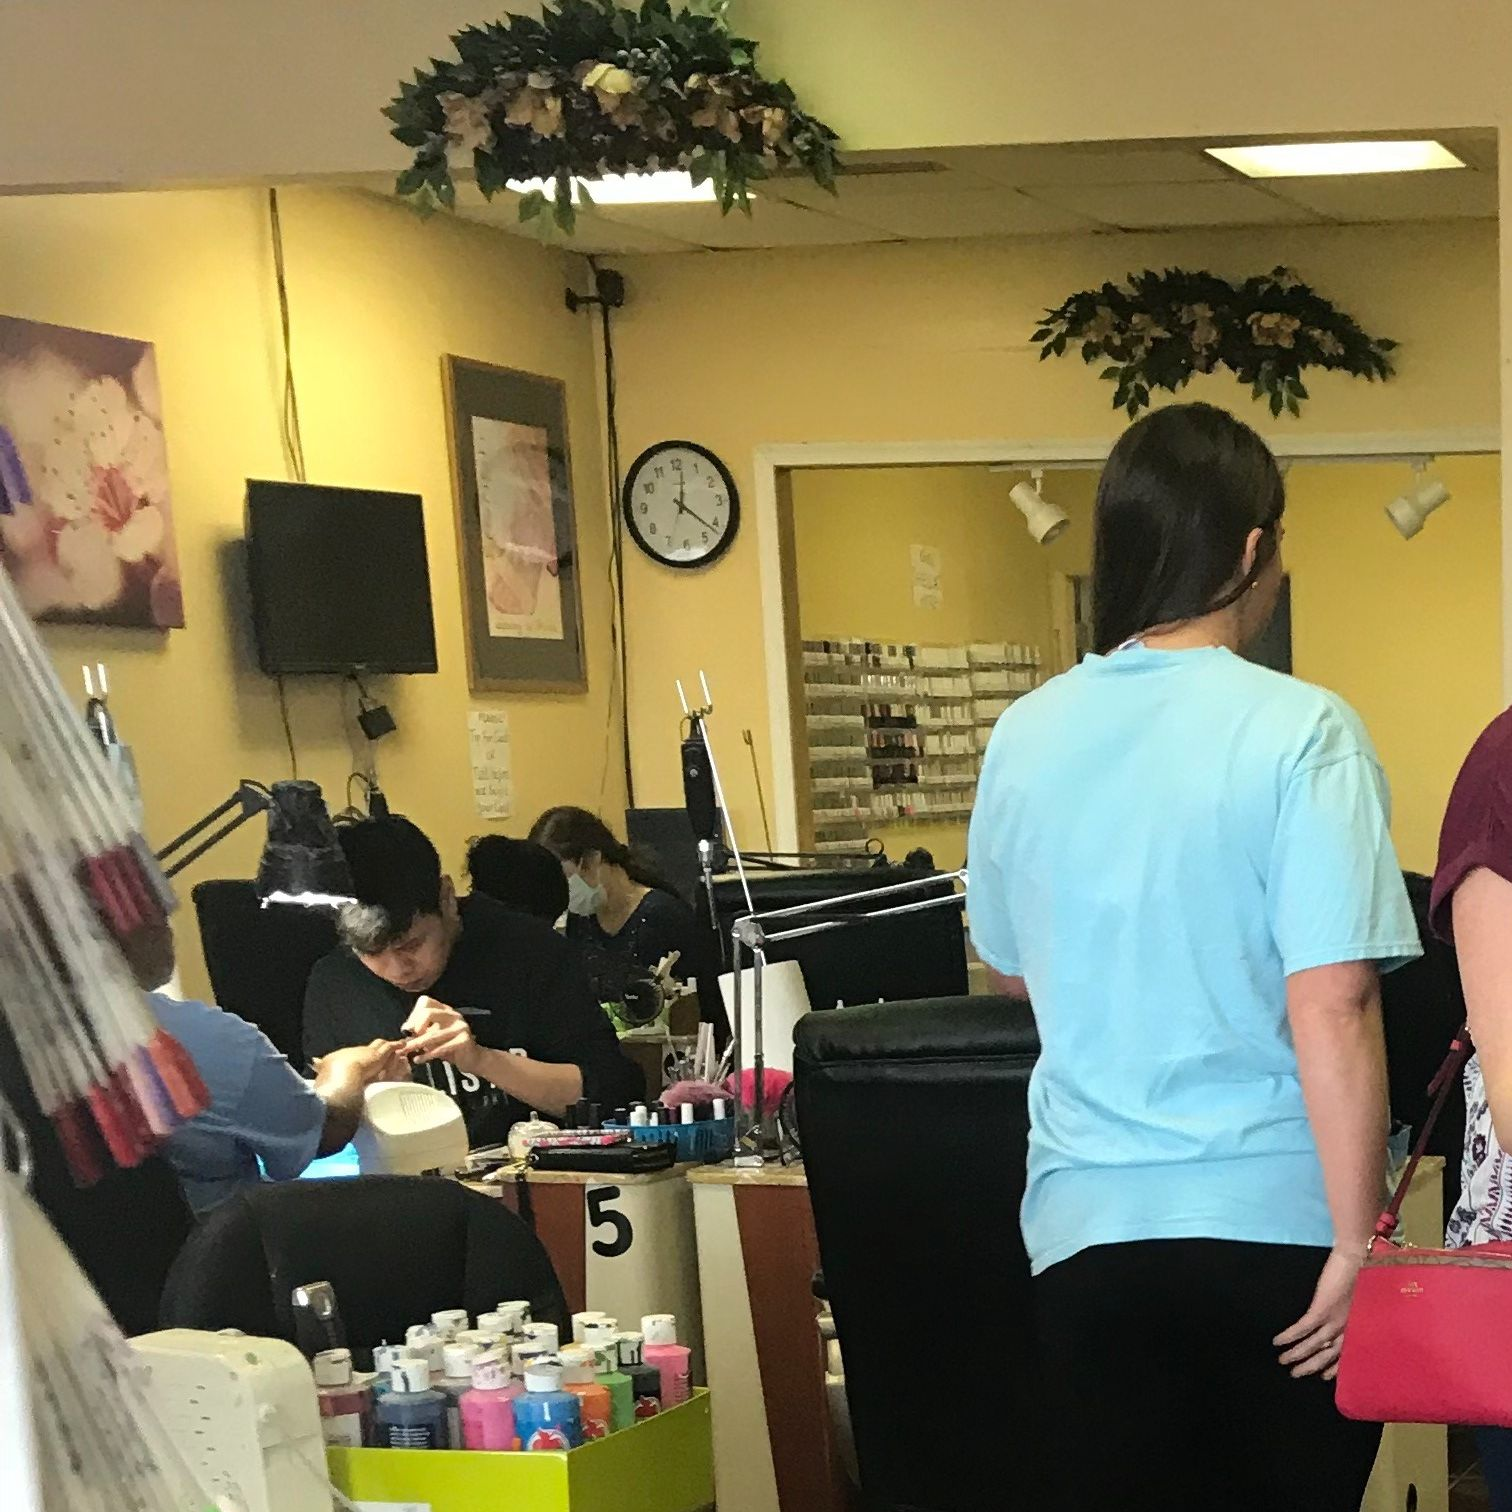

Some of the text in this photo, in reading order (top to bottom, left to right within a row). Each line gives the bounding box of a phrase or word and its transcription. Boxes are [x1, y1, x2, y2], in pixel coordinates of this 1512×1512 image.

[670, 458, 681, 472] 12
[693, 463, 699, 474] 1
[654, 466, 664, 479] 11
[643, 482, 655, 495] 10
[706, 475, 715, 489] 2
[715, 494, 723, 507] 3
[640, 502, 649, 515] 9
[649, 522, 657, 535] 8
[712, 516, 720, 528] 4
[665, 535, 672, 546] 7
[701, 531, 709, 544] 5
[683, 539, 691, 551] 6
[587, 1185, 633, 1257] 5
